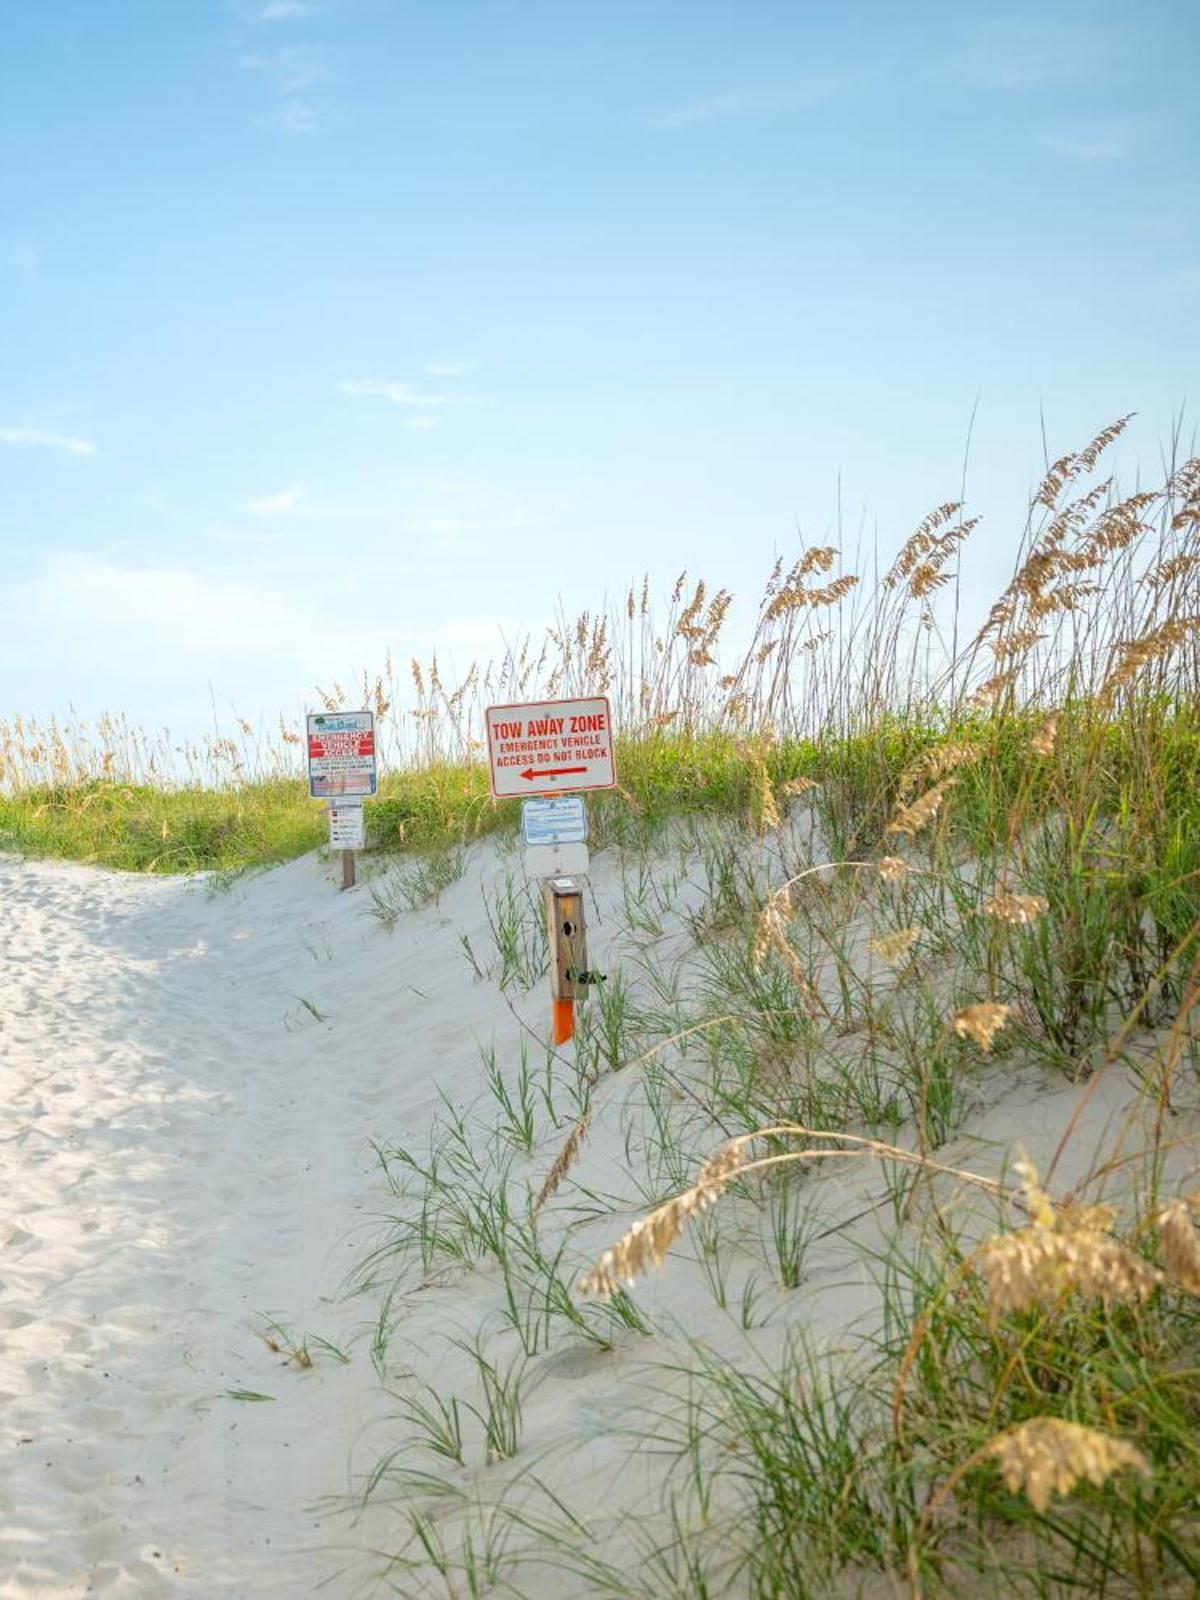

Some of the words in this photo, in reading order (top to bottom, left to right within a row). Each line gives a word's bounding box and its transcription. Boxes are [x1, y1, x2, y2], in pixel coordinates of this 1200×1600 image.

[493, 722, 523, 740] TOW
[528, 718, 564, 736] AWAY
[569, 714, 605, 733] ZONE
[500, 739, 559, 753] EMERGENCY
[562, 734, 601, 748] VEHICLE
[497, 754, 535, 767] ACCESS
[537, 752, 551, 763] DO
[553, 751, 572, 762] NOT
[575, 748, 607, 760] BLOCK
